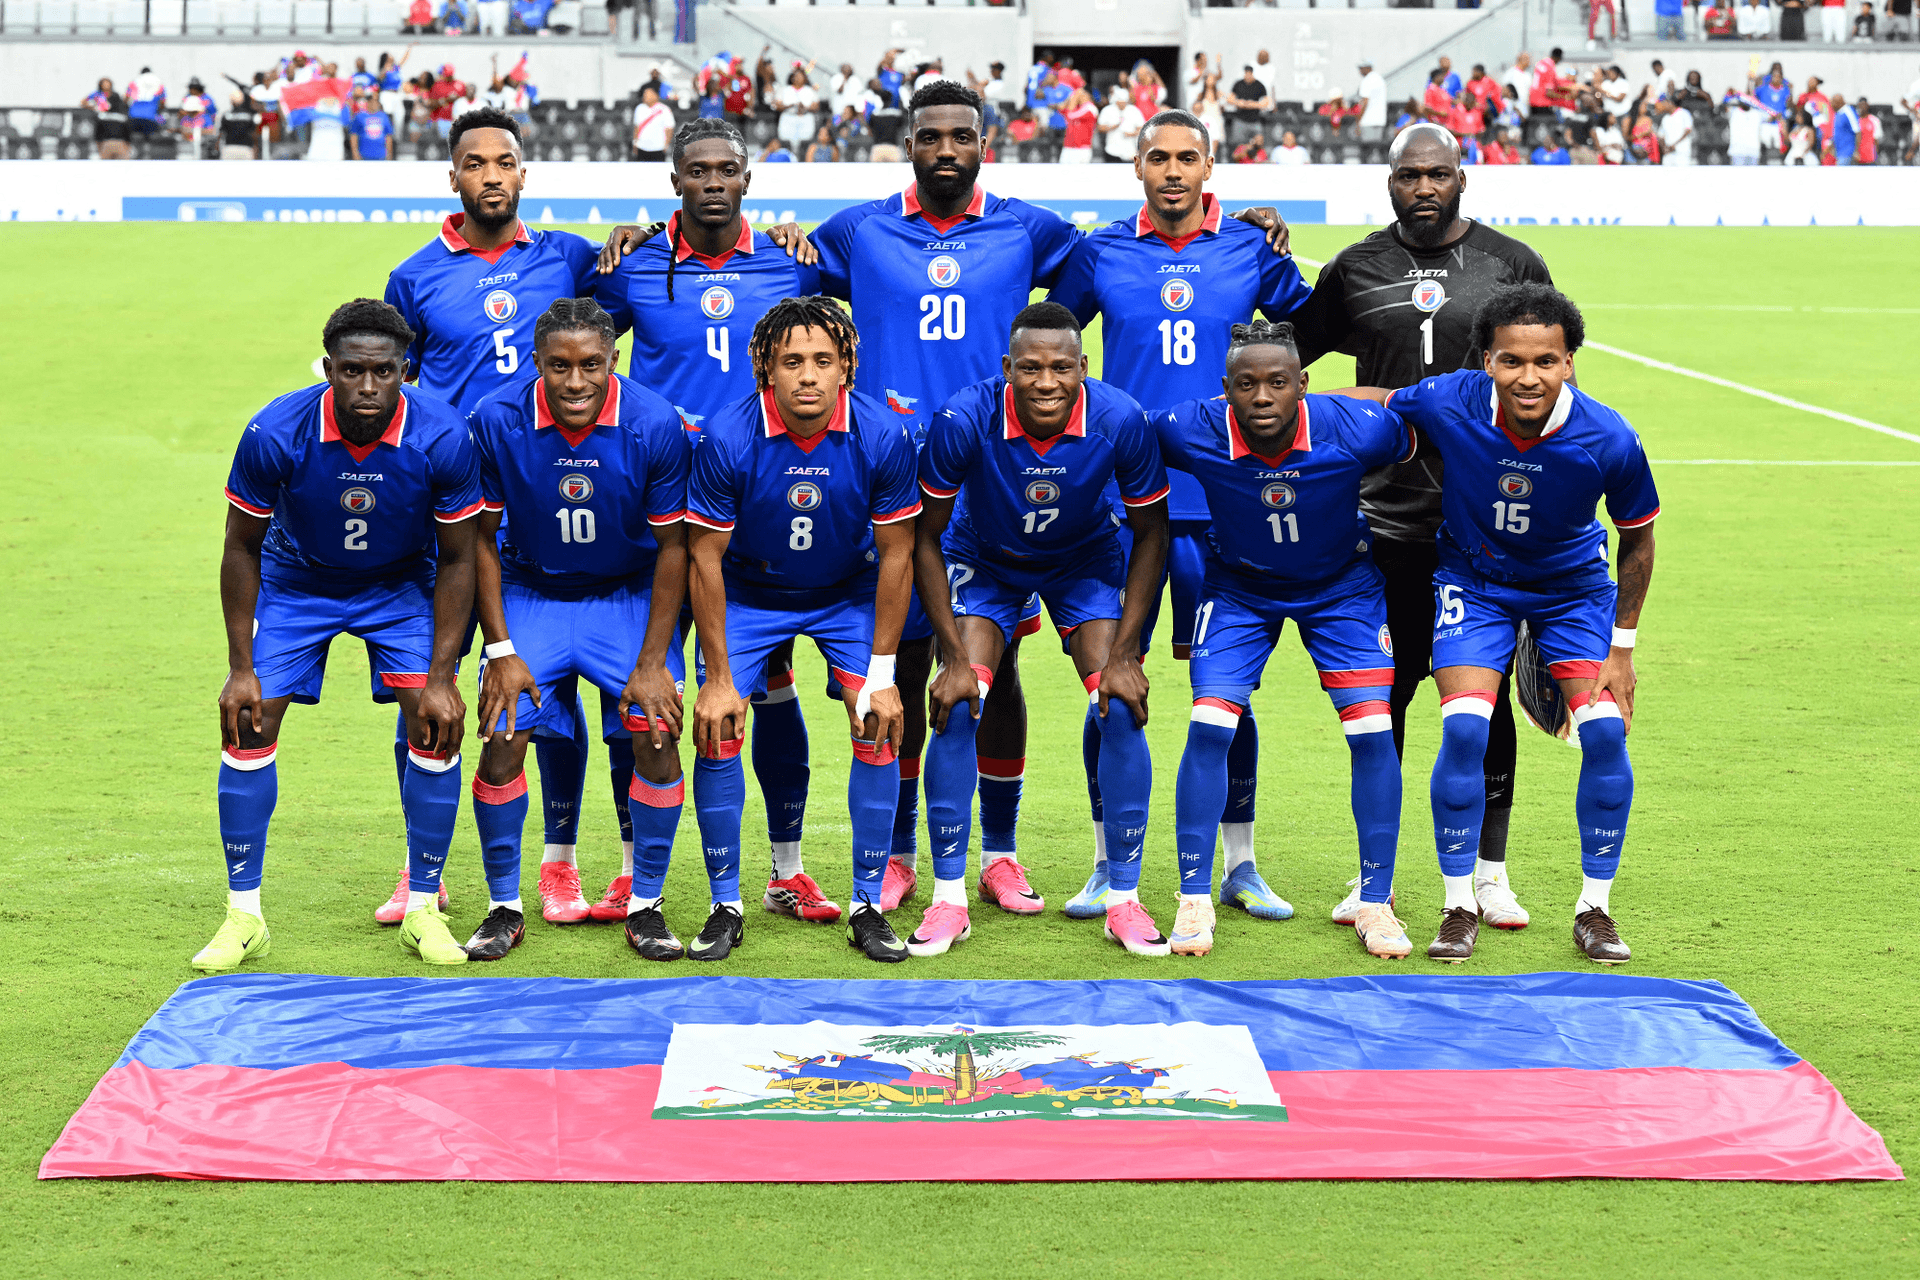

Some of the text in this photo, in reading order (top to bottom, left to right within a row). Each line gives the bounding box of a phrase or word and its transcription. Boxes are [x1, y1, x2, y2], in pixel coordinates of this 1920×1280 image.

[922, 241, 966, 251] SAETA
[1157, 264, 1201, 274] SAETA
[1404, 269, 1449, 278] SAETA
[475, 273, 518, 288] SAETA
[695, 273, 740, 283] SAETA
[919, 294, 966, 341] 20
[1158, 319, 1196, 366] 18
[1420, 318, 1433, 365] 1
[493, 328, 519, 374] 5
[706, 326, 730, 373] 4
[554, 458, 600, 468] SAETA
[1497, 458, 1543, 472] SAETA
[784, 466, 830, 476] SAETA
[1021, 466, 1067, 475] SAETA
[1254, 470, 1301, 479] SAETA
[337, 472, 384, 482] SAETA
[1022, 508, 1060, 534] 17
[1492, 501, 1531, 534] 15
[556, 508, 596, 544] 10
[1266, 513, 1300, 544] 11
[344, 519, 368, 550] 2
[789, 516, 813, 551] 8
[1436, 585, 1465, 629] 15
[1192, 601, 1214, 646] 11
[1232, 777, 1254, 786] FHF
[1484, 773, 1507, 782] FHF
[552, 801, 573, 810] FHF
[785, 801, 804, 810] FHF
[941, 825, 963, 835] FHF
[1127, 824, 1145, 837] FHF
[1444, 828, 1469, 837] FHF
[1595, 828, 1619, 838] FHF
[227, 843, 251, 853] FHF
[707, 847, 729, 857] FHF
[423, 853, 444, 863] FHF
[865, 850, 887, 858] FHF
[1182, 853, 1200, 861] FHF
[1363, 859, 1380, 869] FHF
